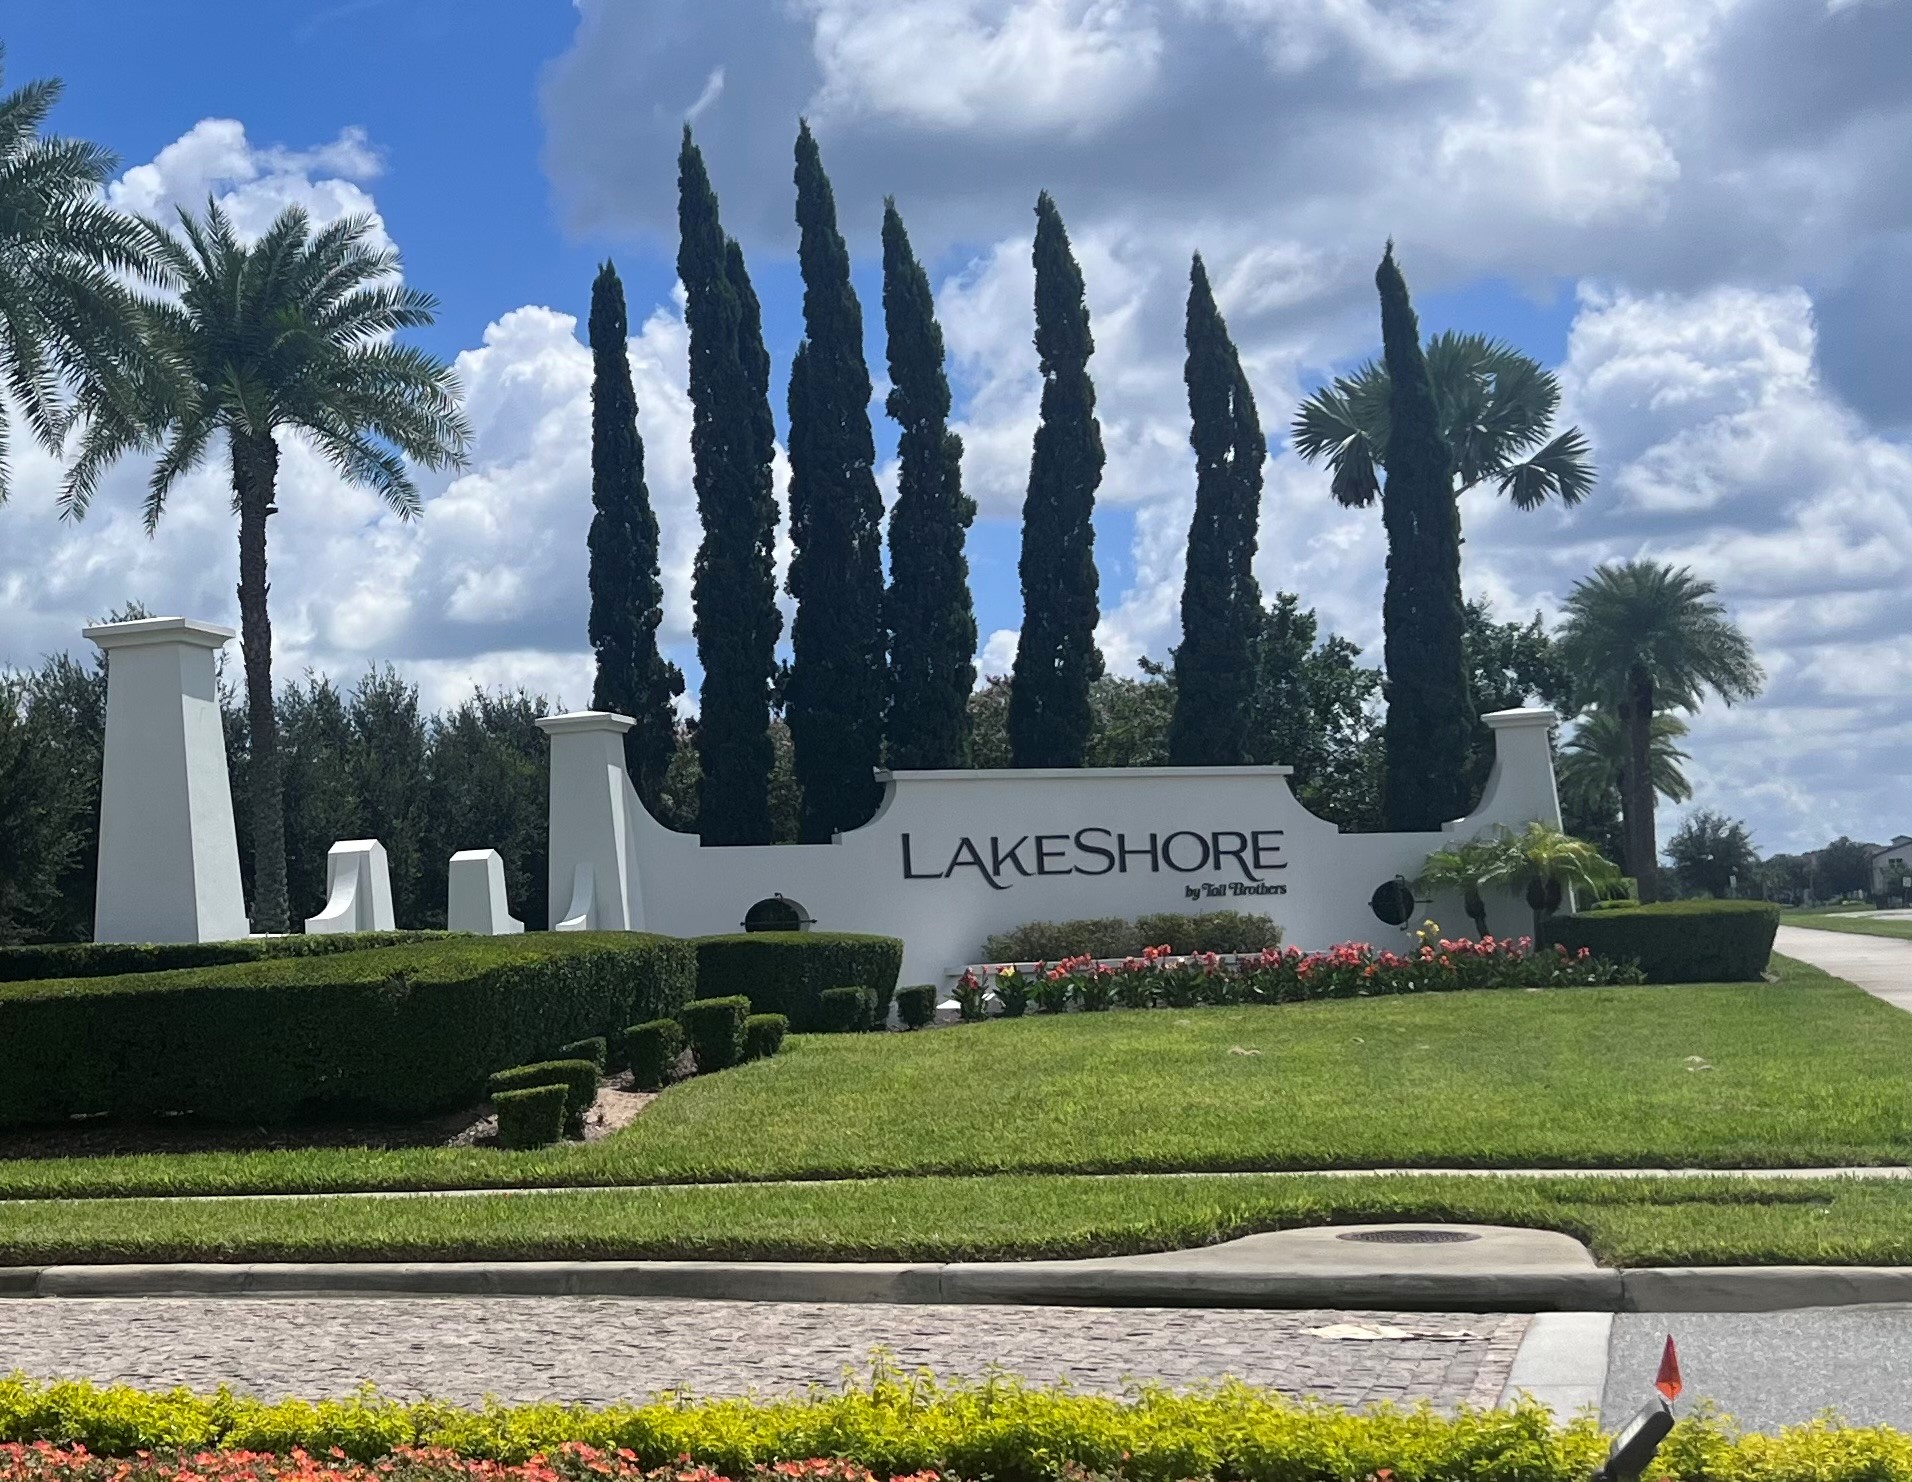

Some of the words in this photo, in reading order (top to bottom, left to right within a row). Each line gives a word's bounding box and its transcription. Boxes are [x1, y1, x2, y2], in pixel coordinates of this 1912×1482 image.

[901, 827, 1288, 890] LAKESHORE
[1184, 885, 1200, 901] by
[1201, 882, 1227, 897] Toll
[1228, 882, 1287, 896] Brothers
